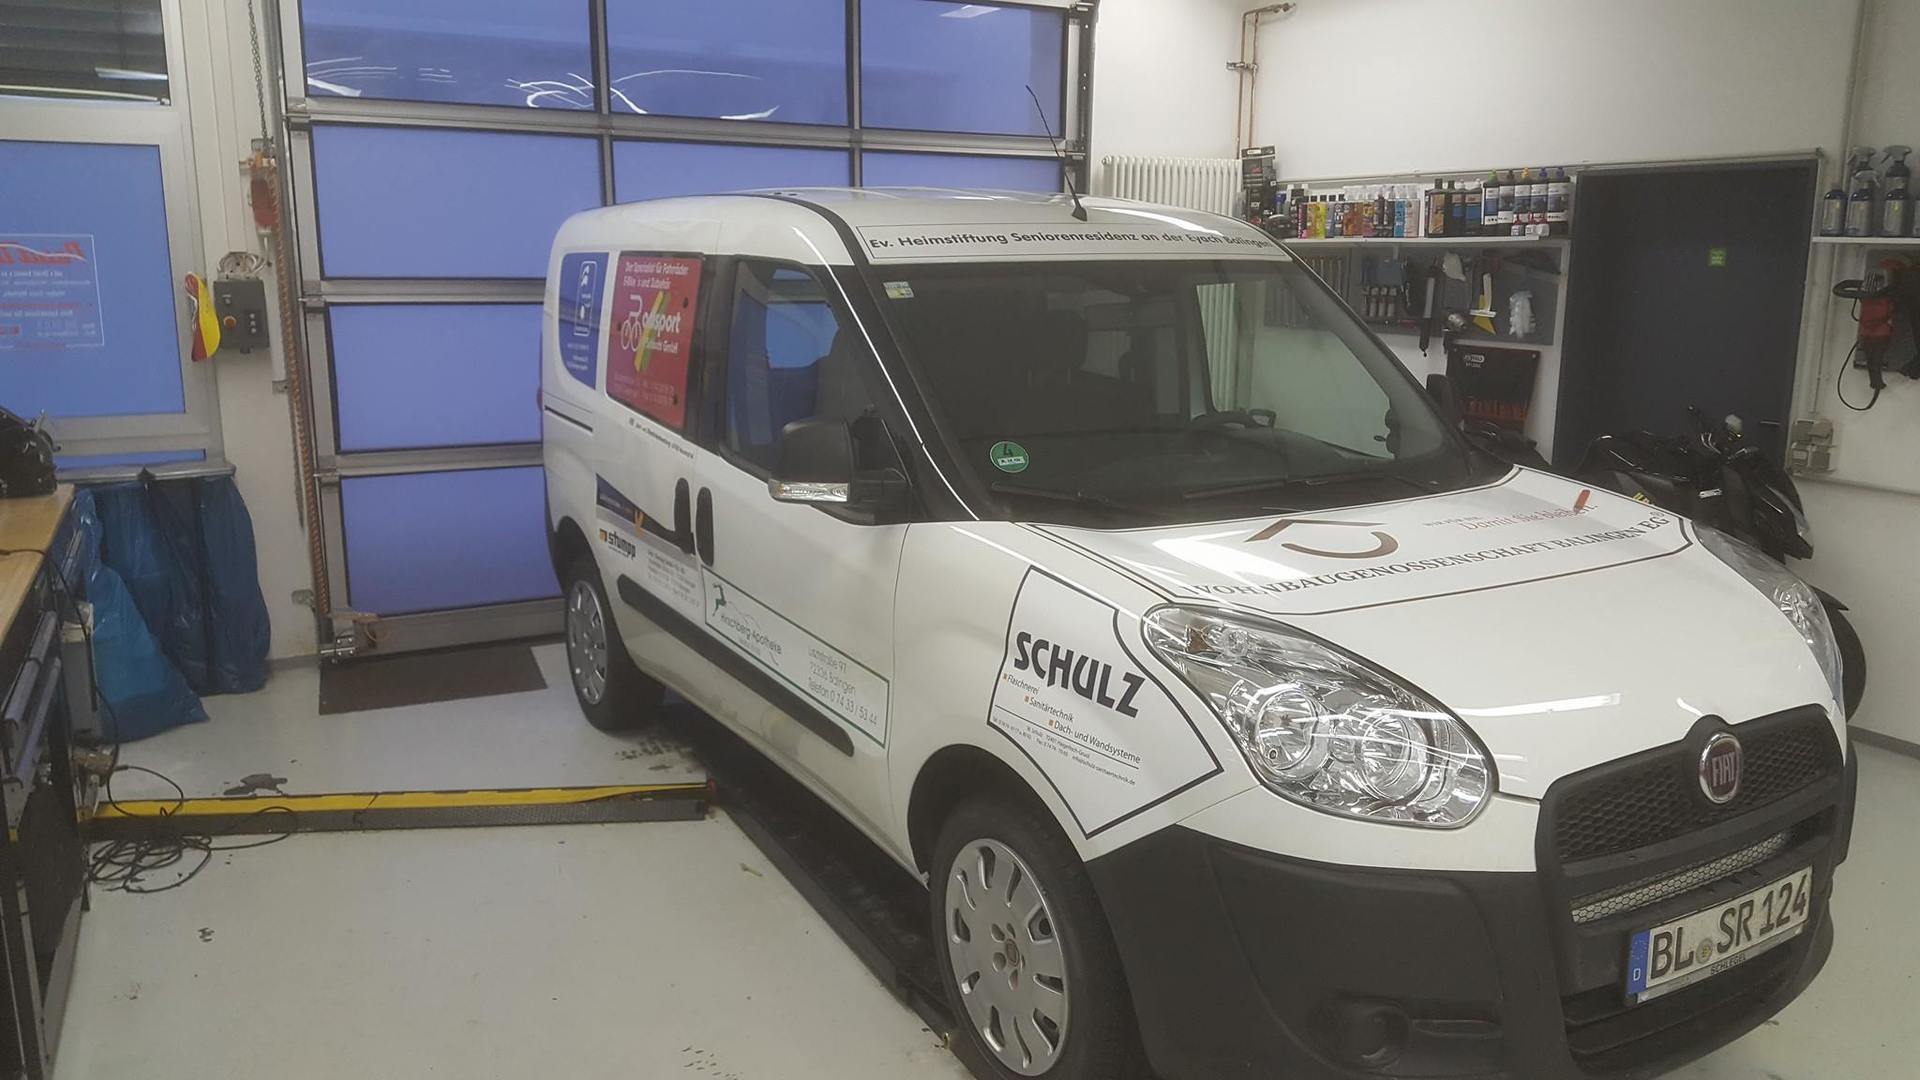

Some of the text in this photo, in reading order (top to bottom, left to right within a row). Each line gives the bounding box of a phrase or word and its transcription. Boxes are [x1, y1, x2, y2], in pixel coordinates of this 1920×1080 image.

[870, 239, 893, 248] Ev.
[898, 233, 1008, 247] Heimstiftung
[1011, 231, 1137, 243] Seniorenresidenz
[1162, 232, 1183, 242] der
[1186, 233, 1222, 244] Eyach
[1003, 443, 1013, 456] 4
[1551, 527, 1646, 550] BALINGEN
[1007, 673, 1040, 695] Flaschnerei
[1013, 631, 1146, 719] SCHULZ
[1029, 696, 1074, 723] Sanitärtechnik
[1054, 719, 1141, 765] Dach- und Wandsysteme
[1711, 751, 1737, 787] FIAT
[1651, 873, 1808, 980] BL SR 124
[1633, 968, 1641, 981] D
